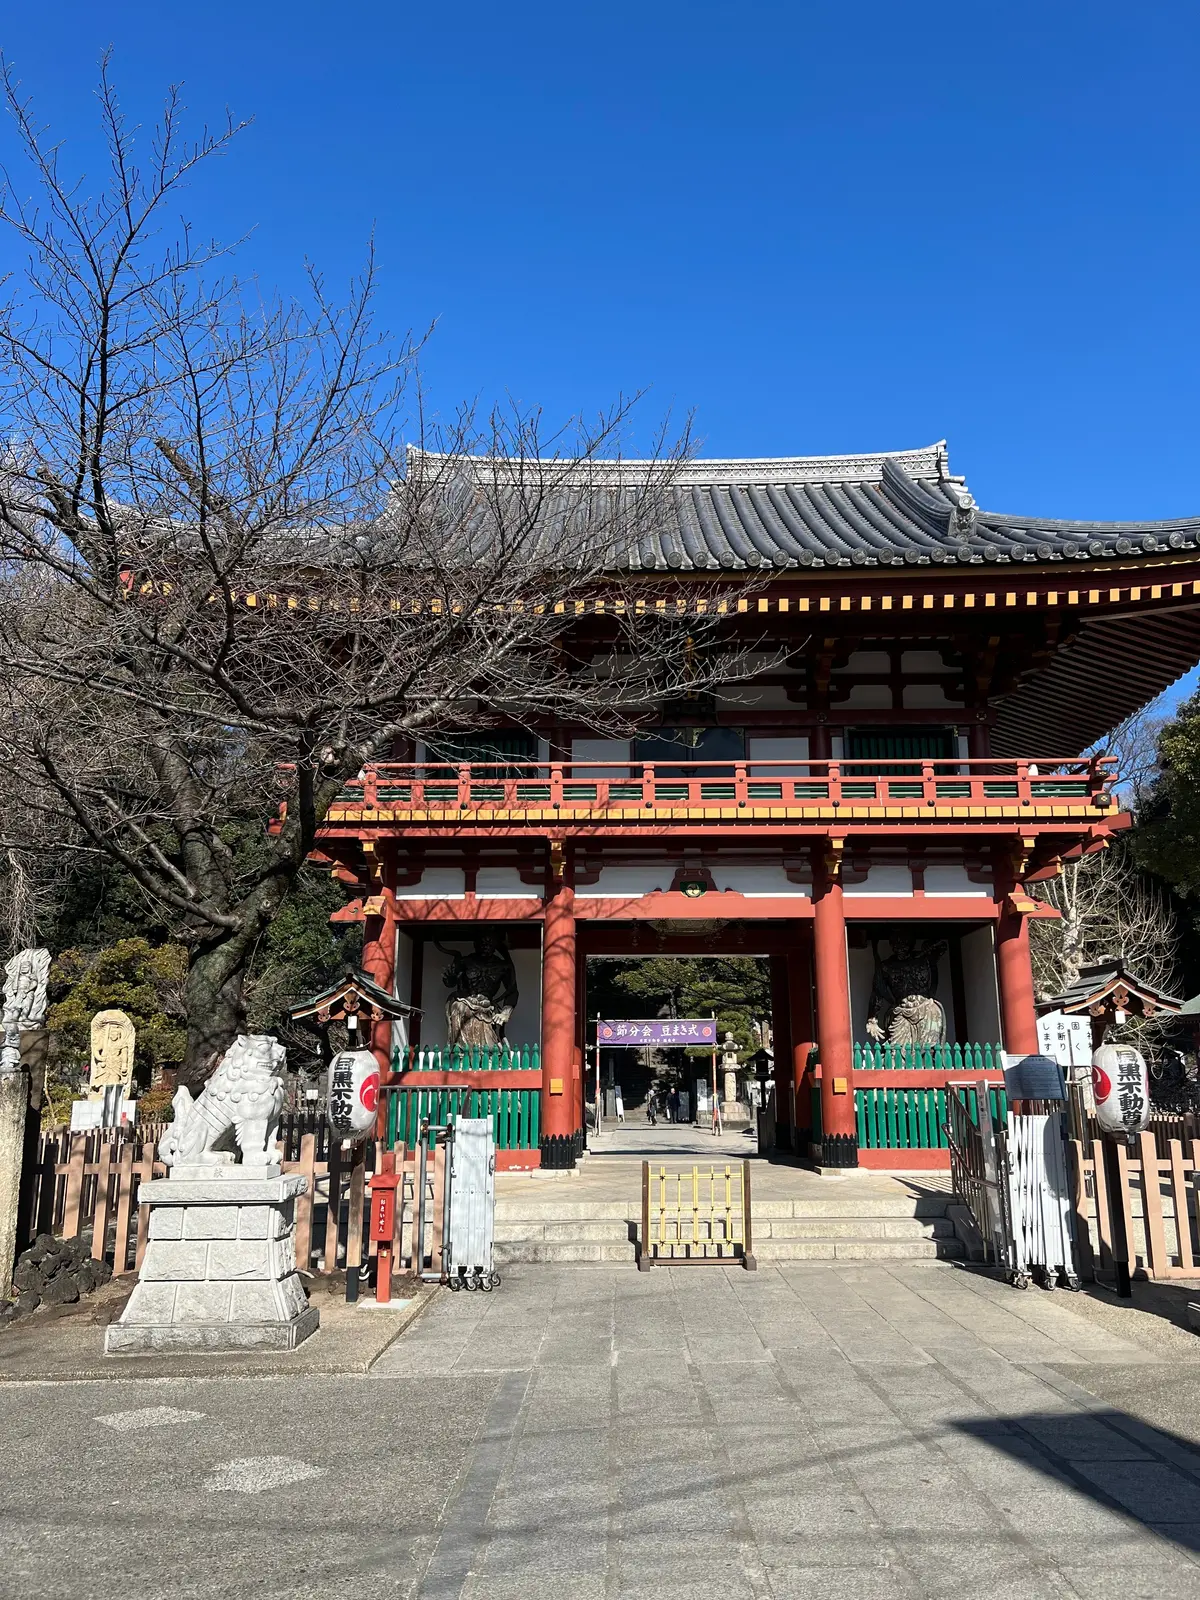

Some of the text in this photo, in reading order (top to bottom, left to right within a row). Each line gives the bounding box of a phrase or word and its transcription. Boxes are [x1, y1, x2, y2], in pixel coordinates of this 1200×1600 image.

[616, 1023, 699, 1037] 節分会 豆まき式
[1042, 1022, 1052, 1052] します
[1056, 1022, 1067, 1051] お断り
[1071, 1021, 1081, 1051] 固く
[331, 1057, 355, 1132] 目黒不動尊
[1117, 1049, 1144, 1129] 目黒不動尊
